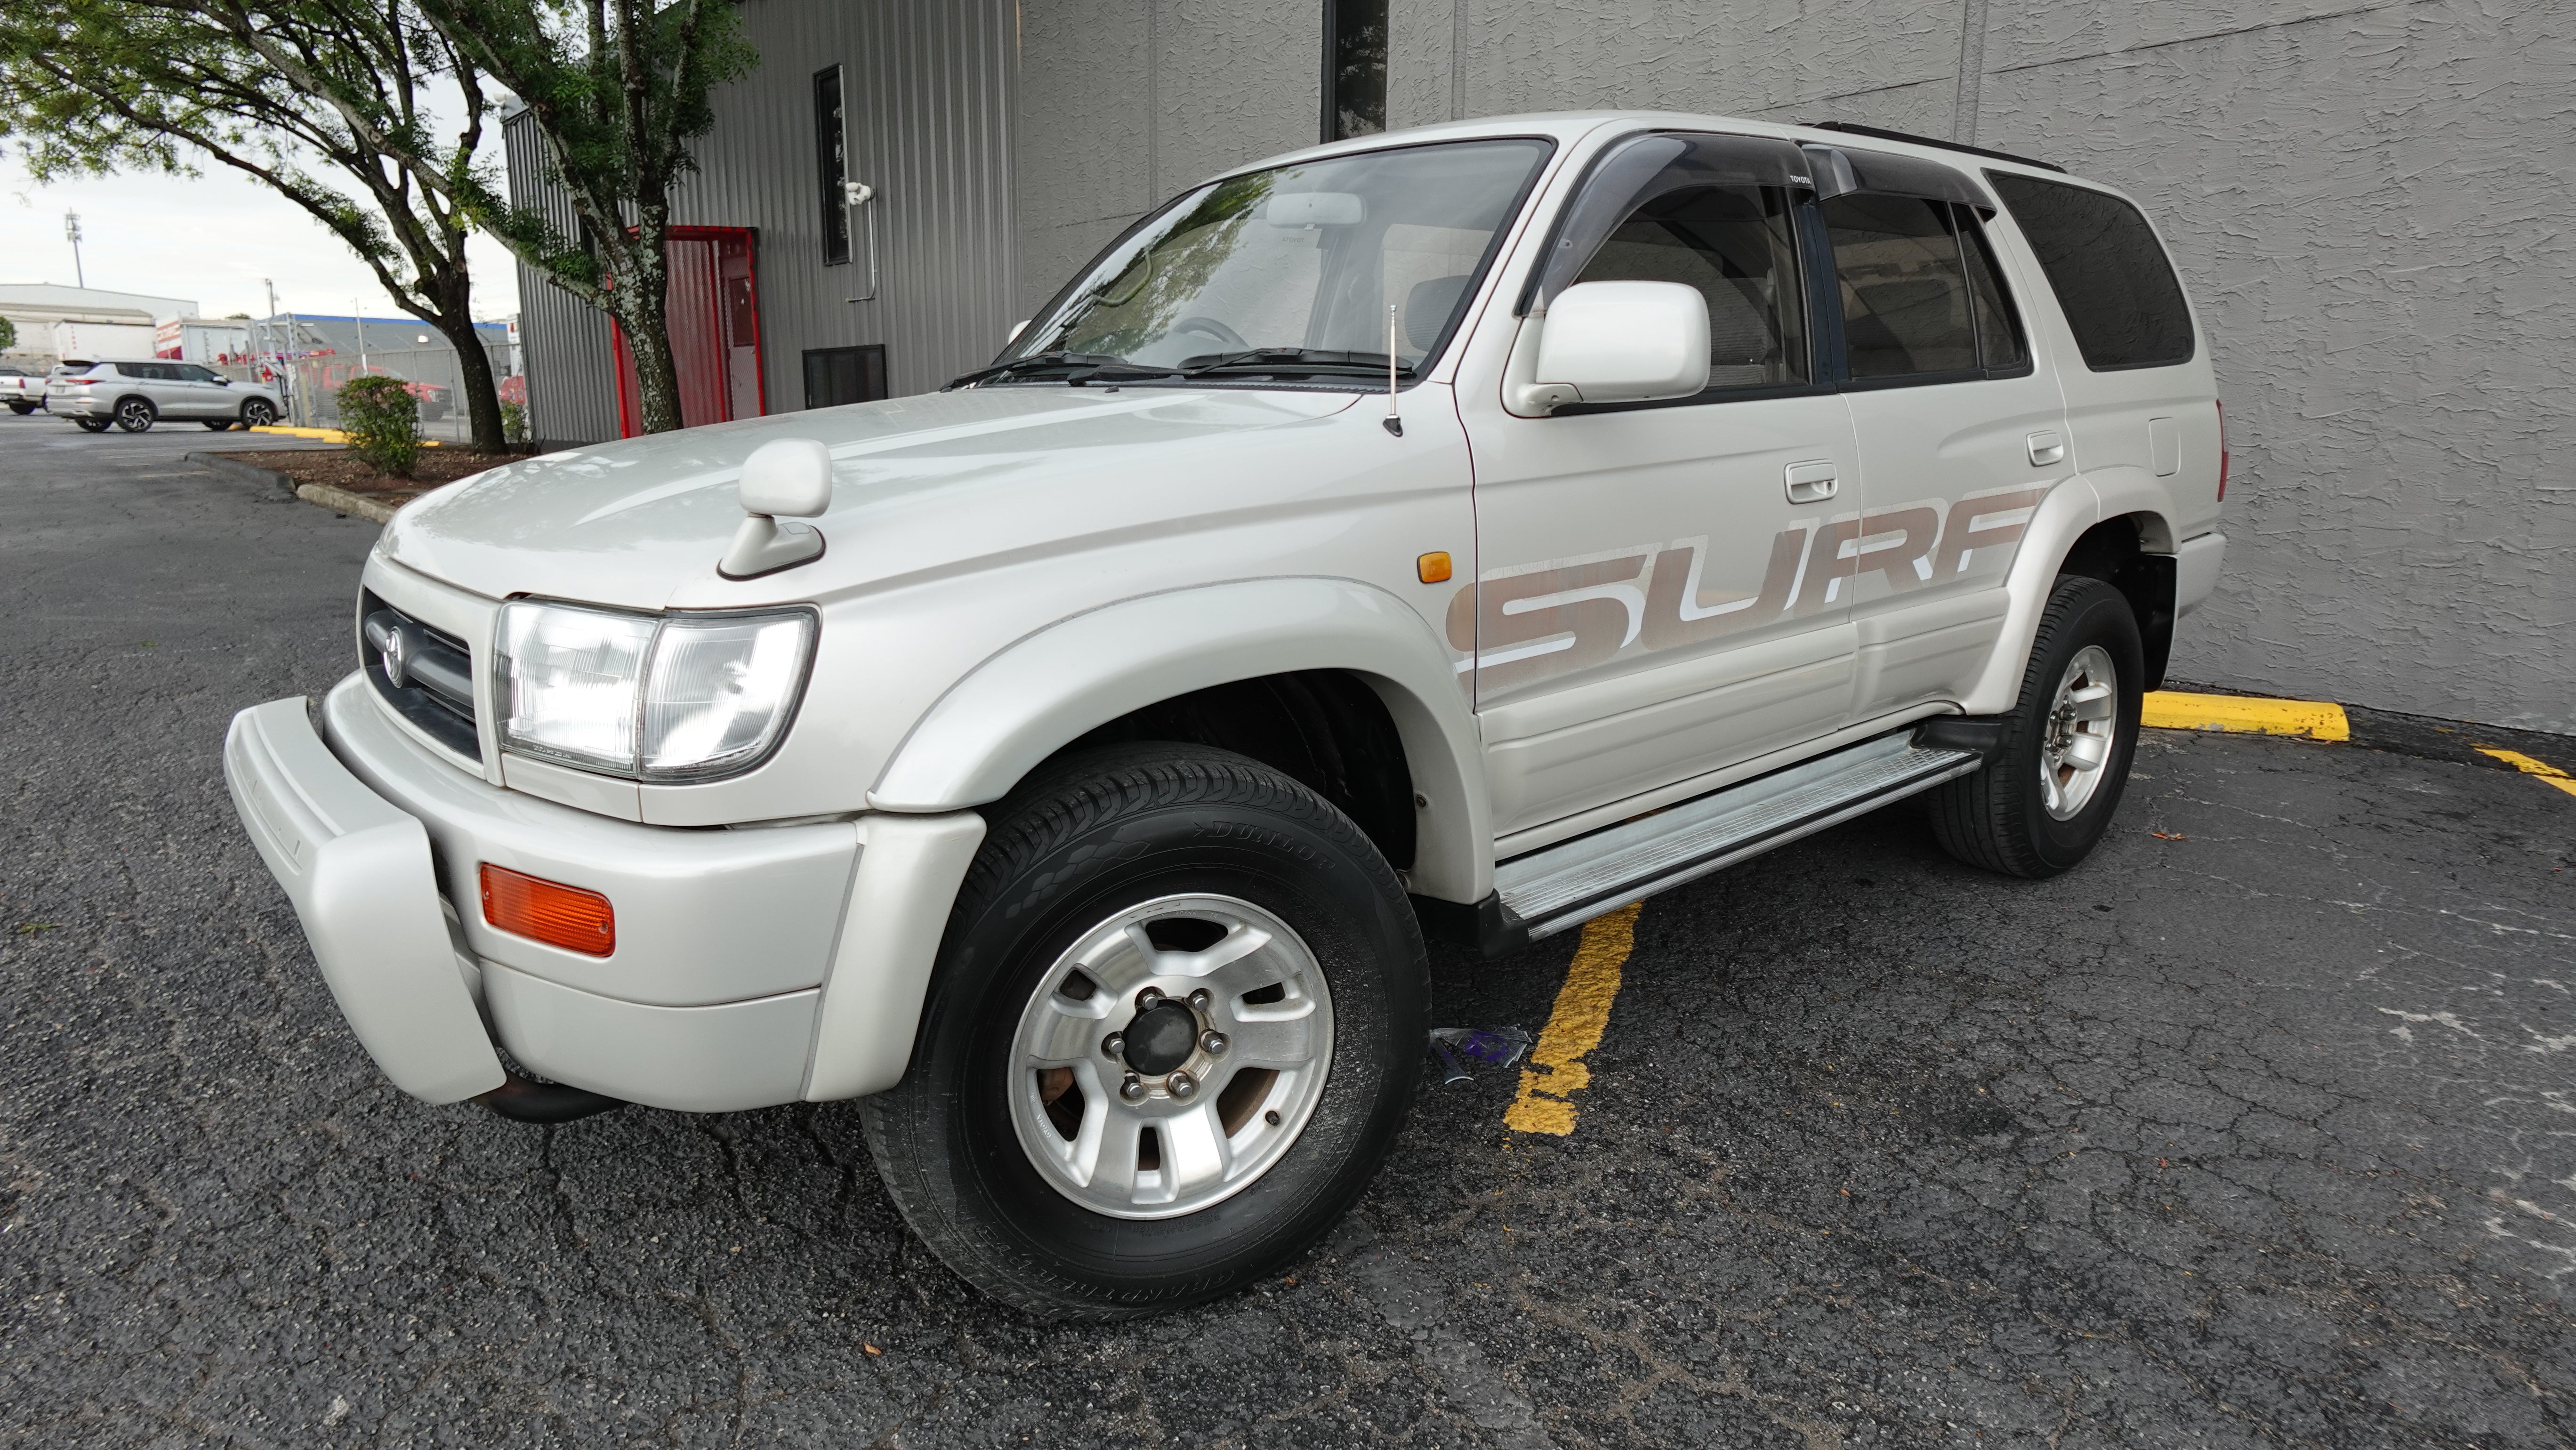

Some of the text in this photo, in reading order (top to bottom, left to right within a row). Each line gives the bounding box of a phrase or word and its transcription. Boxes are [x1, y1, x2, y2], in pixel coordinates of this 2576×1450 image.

[1789, 175, 1811, 185] TOYOTA
[1445, 480, 2053, 696] SURF
[1207, 822, 1336, 869] DUNLOP
[1037, 1114, 1052, 1138] TOYOTA
